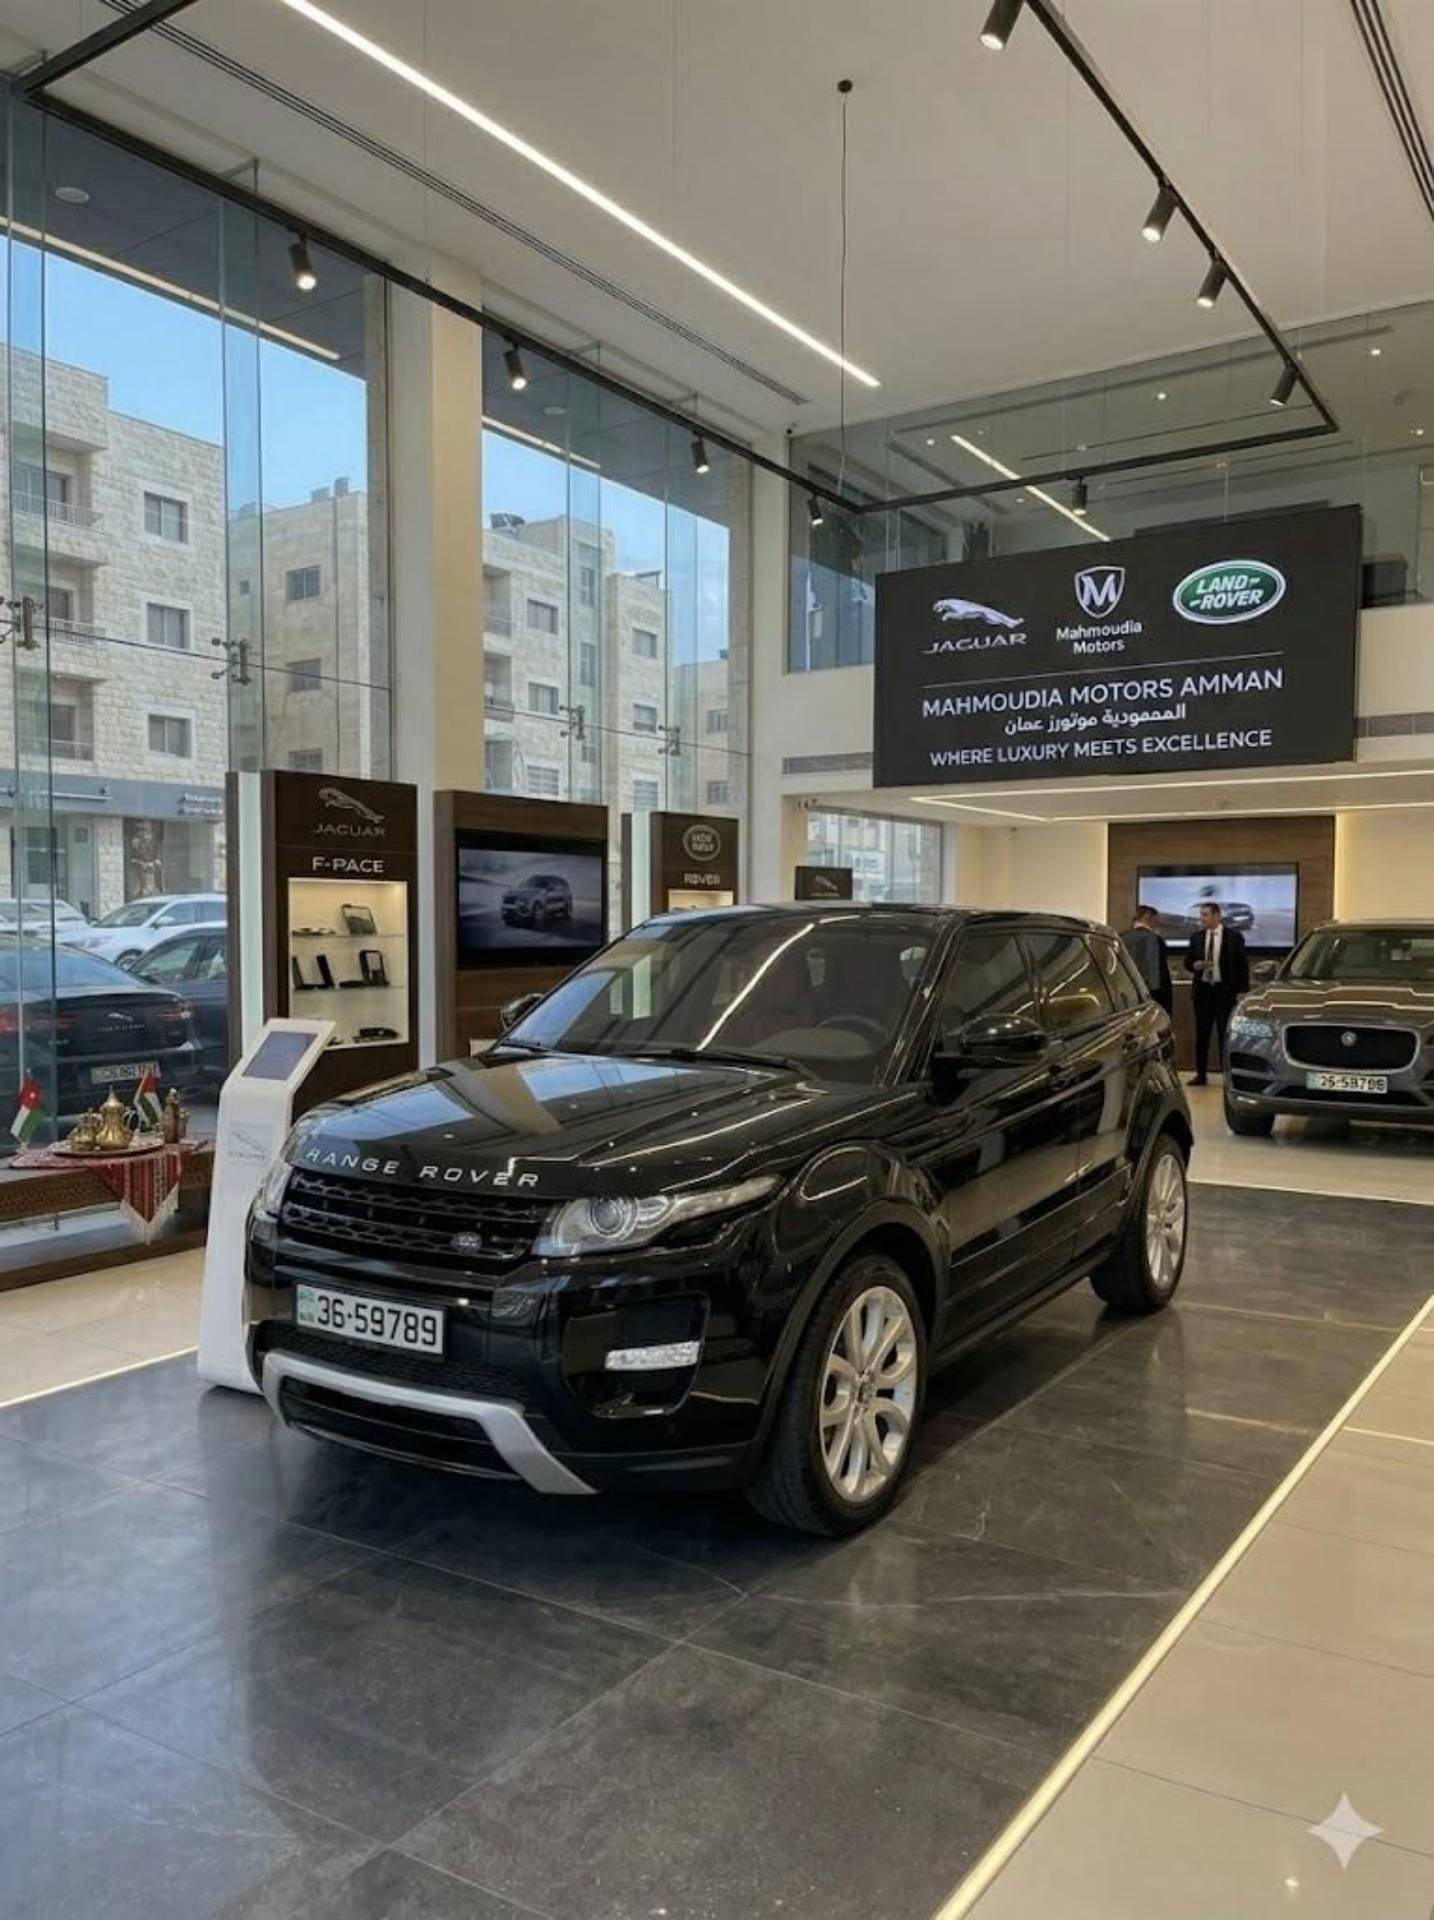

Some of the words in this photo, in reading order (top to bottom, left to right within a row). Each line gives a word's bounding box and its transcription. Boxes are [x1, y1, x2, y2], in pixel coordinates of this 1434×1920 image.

[1055, 619, 1142, 641] Mahmoudia
[922, 632, 1028, 654] JAGUAR
[1072, 638, 1126, 655] Motors
[922, 687, 1063, 717] MAHMOUDIA
[1070, 678, 1173, 705] MOTORS
[1179, 667, 1284, 697] AMMAN
[1004, 716, 1044, 736] عمان
[1047, 711, 1098, 733] موتورز
[929, 747, 993, 767] WHERE
[997, 743, 1069, 763] LUXURY
[1073, 738, 1138, 758] MEETS
[1142, 729, 1273, 753] EXCELLENCE
[313, 823, 386, 837] JAGUAR
[312, 855, 386, 873] F-PACE
[305, 1148, 400, 1175] RANGE
[418, 1165, 540, 1187] ROVER
